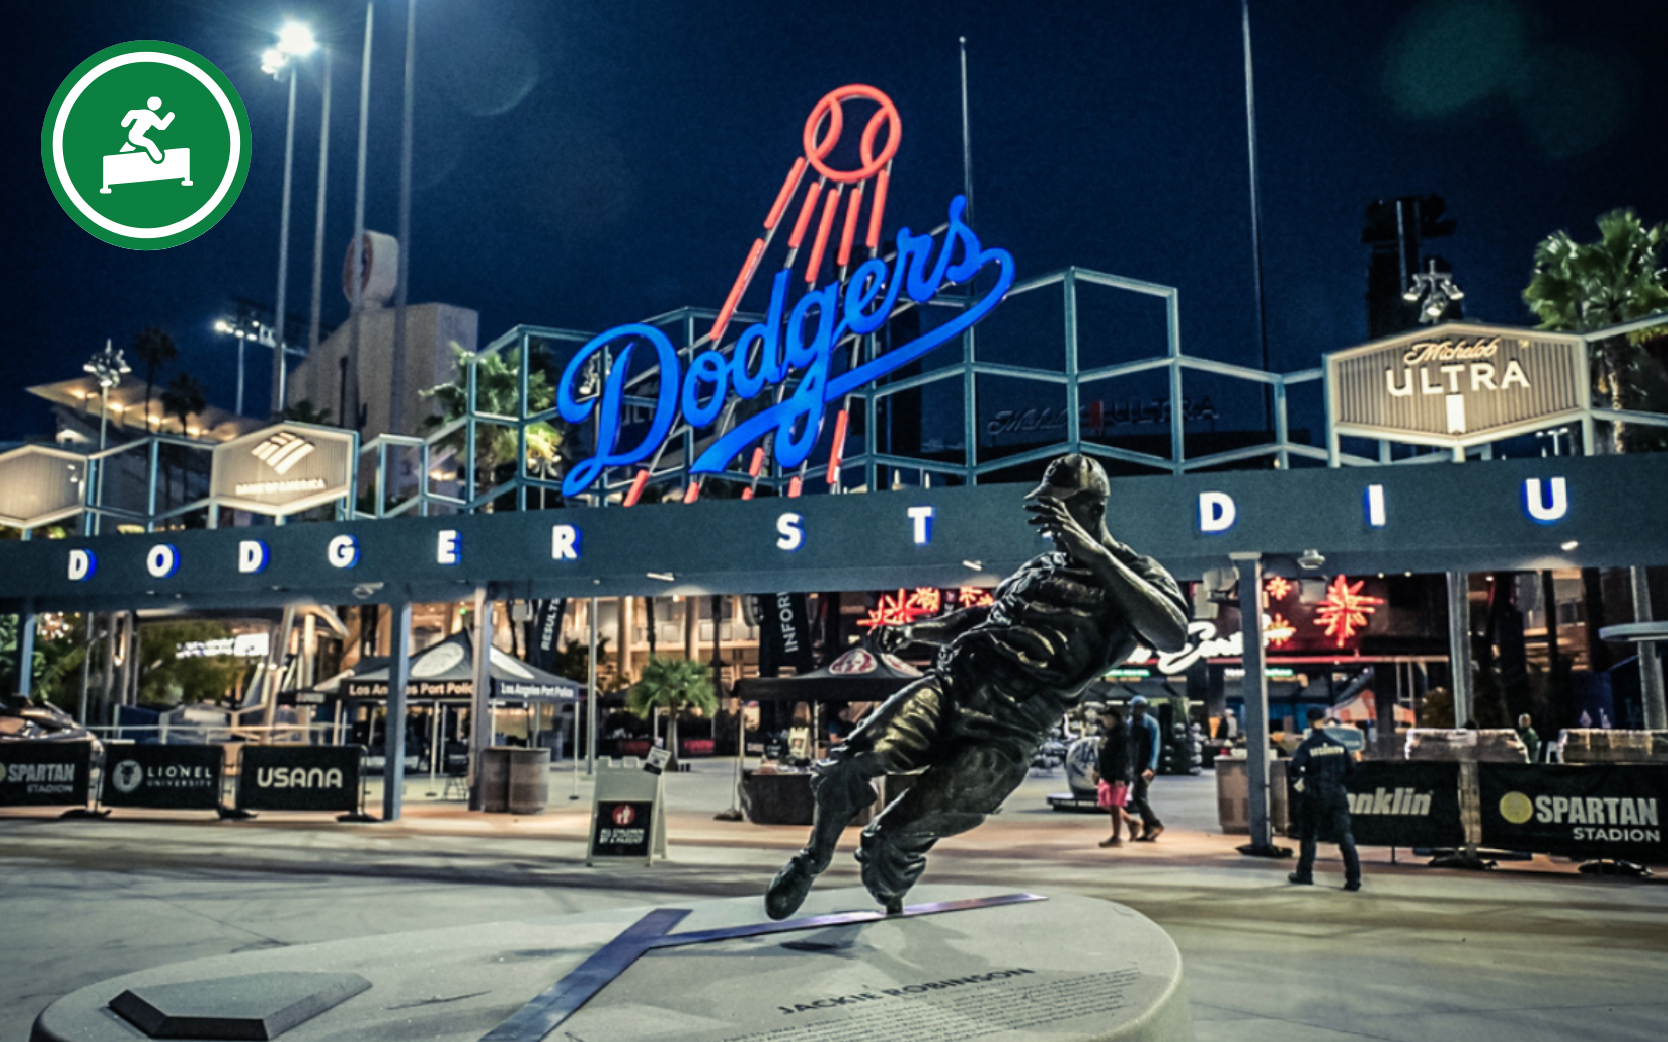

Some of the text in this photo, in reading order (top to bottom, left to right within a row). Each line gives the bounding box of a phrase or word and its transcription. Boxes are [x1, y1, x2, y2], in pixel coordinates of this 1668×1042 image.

[557, 194, 1015, 498] Dodgers
[1403, 336, 1500, 365] Michelob
[1386, 359, 1531, 397] ULTRA
[68, 476, 1569, 581] DODGER STDIU
[420, 682, 445, 695] Port
[446, 682, 474, 695] Polic
[8, 763, 75, 783] SPARTAN
[147, 765, 212, 778] LIONEL
[257, 766, 343, 788] USANA
[1535, 795, 1659, 826] SPARTAN
[1573, 827, 1661, 842] STADION
[882, 967, 1035, 996] ROBINSON
